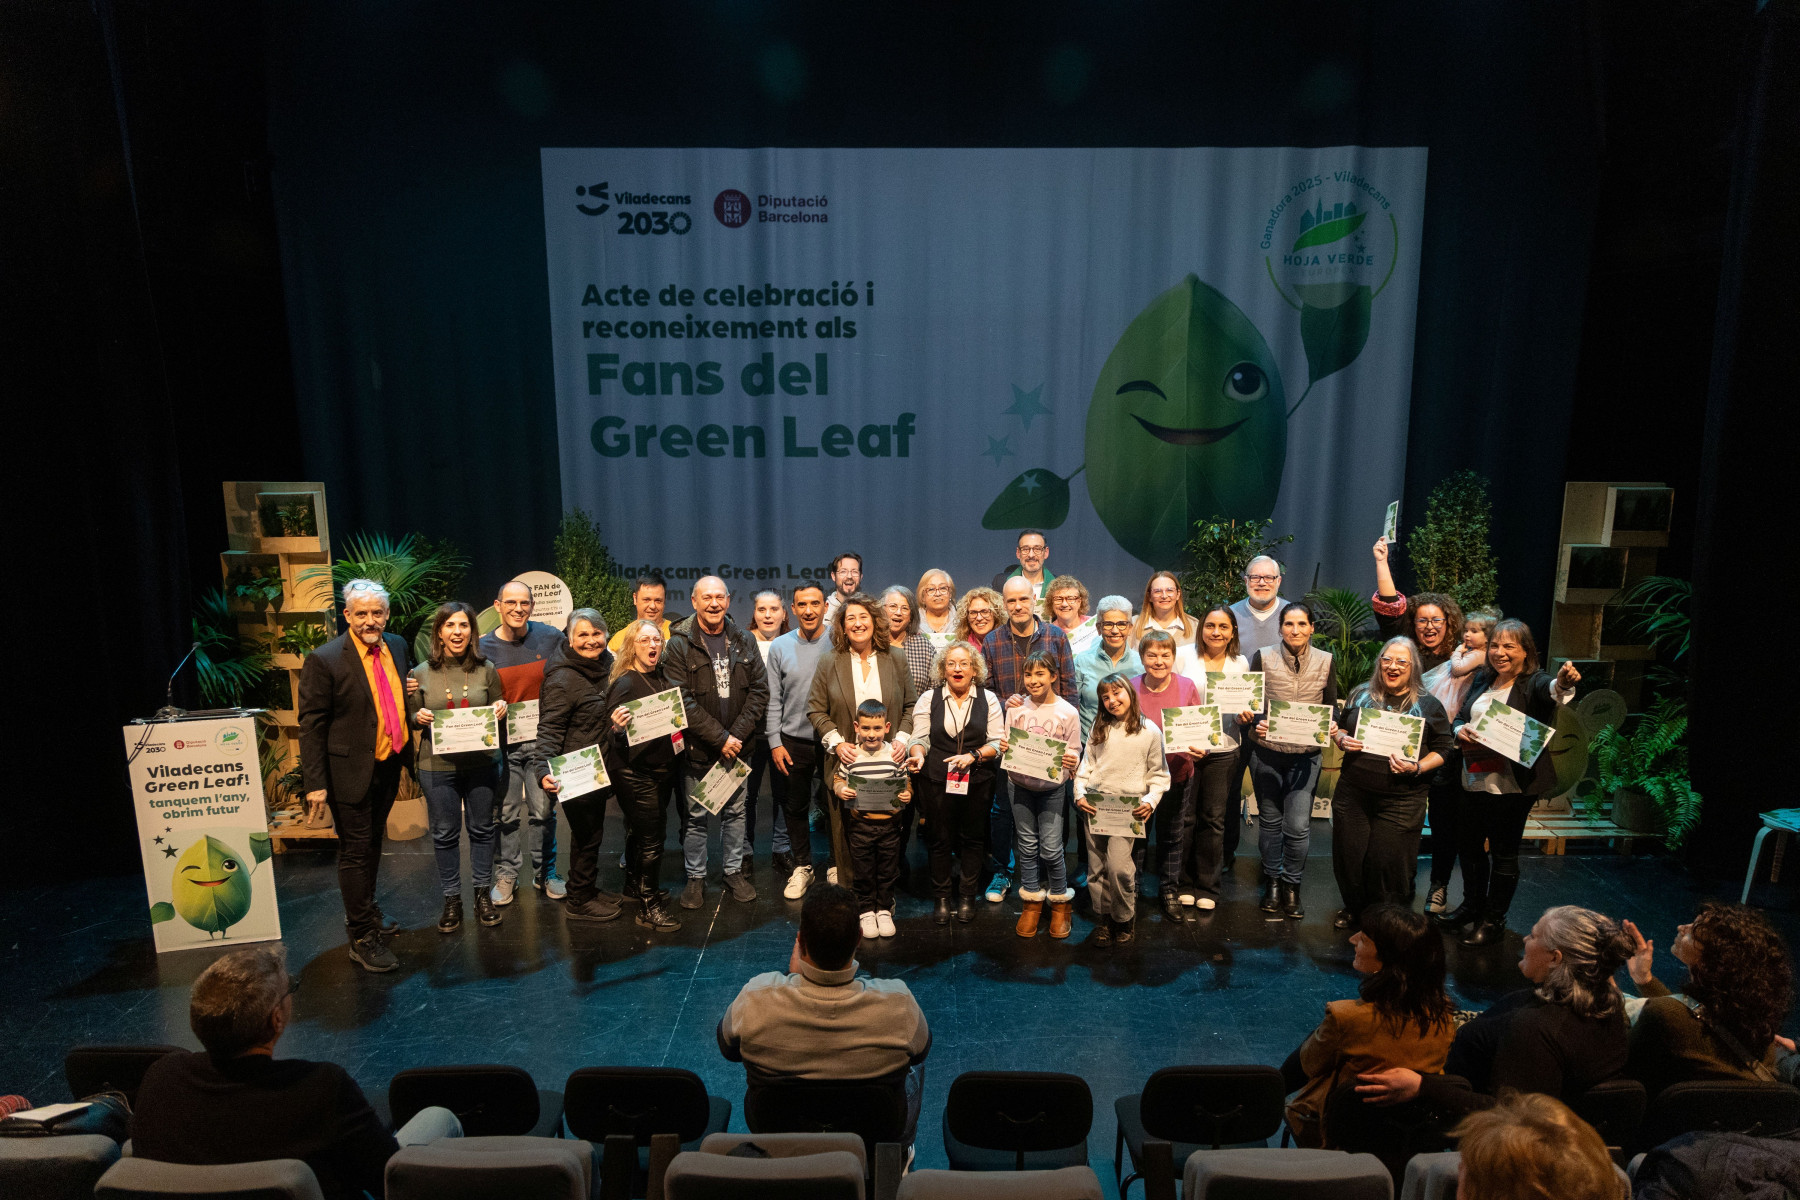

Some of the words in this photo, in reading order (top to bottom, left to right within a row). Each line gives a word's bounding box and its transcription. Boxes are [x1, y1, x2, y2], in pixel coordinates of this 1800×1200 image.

[614, 191, 692, 205] Viladecans
[758, 194, 828, 210] Diputació
[758, 211, 828, 224] Barcelona
[1260, 194, 1292, 250] Ganadora
[1292, 174, 1322, 196] 2025
[1334, 171, 1391, 210] Viladecans
[617, 211, 692, 236] 2030
[1284, 254, 1320, 266] HOJA
[1328, 253, 1374, 266] VERDE
[582, 283, 650, 307] Acte
[658, 283, 695, 307] de
[702, 281, 858, 307] celebració
[866, 281, 874, 306] i
[583, 314, 808, 339] reconeixement
[814, 316, 857, 339] als
[586, 352, 725, 396] Fans
[740, 352, 829, 396] del
[590, 416, 766, 459] Green
[783, 412, 917, 458] Leaf
[609, 563, 712, 580] iladecans
[717, 564, 781, 580] Green
[146, 762, 244, 778] Viladecans
[144, 780, 199, 793] Green
[203, 774, 250, 788] Leaf!
[149, 796, 212, 808] tanquem
[215, 793, 250, 803] l'any,
[163, 808, 203, 819] obrim
[206, 805, 240, 816] futur
